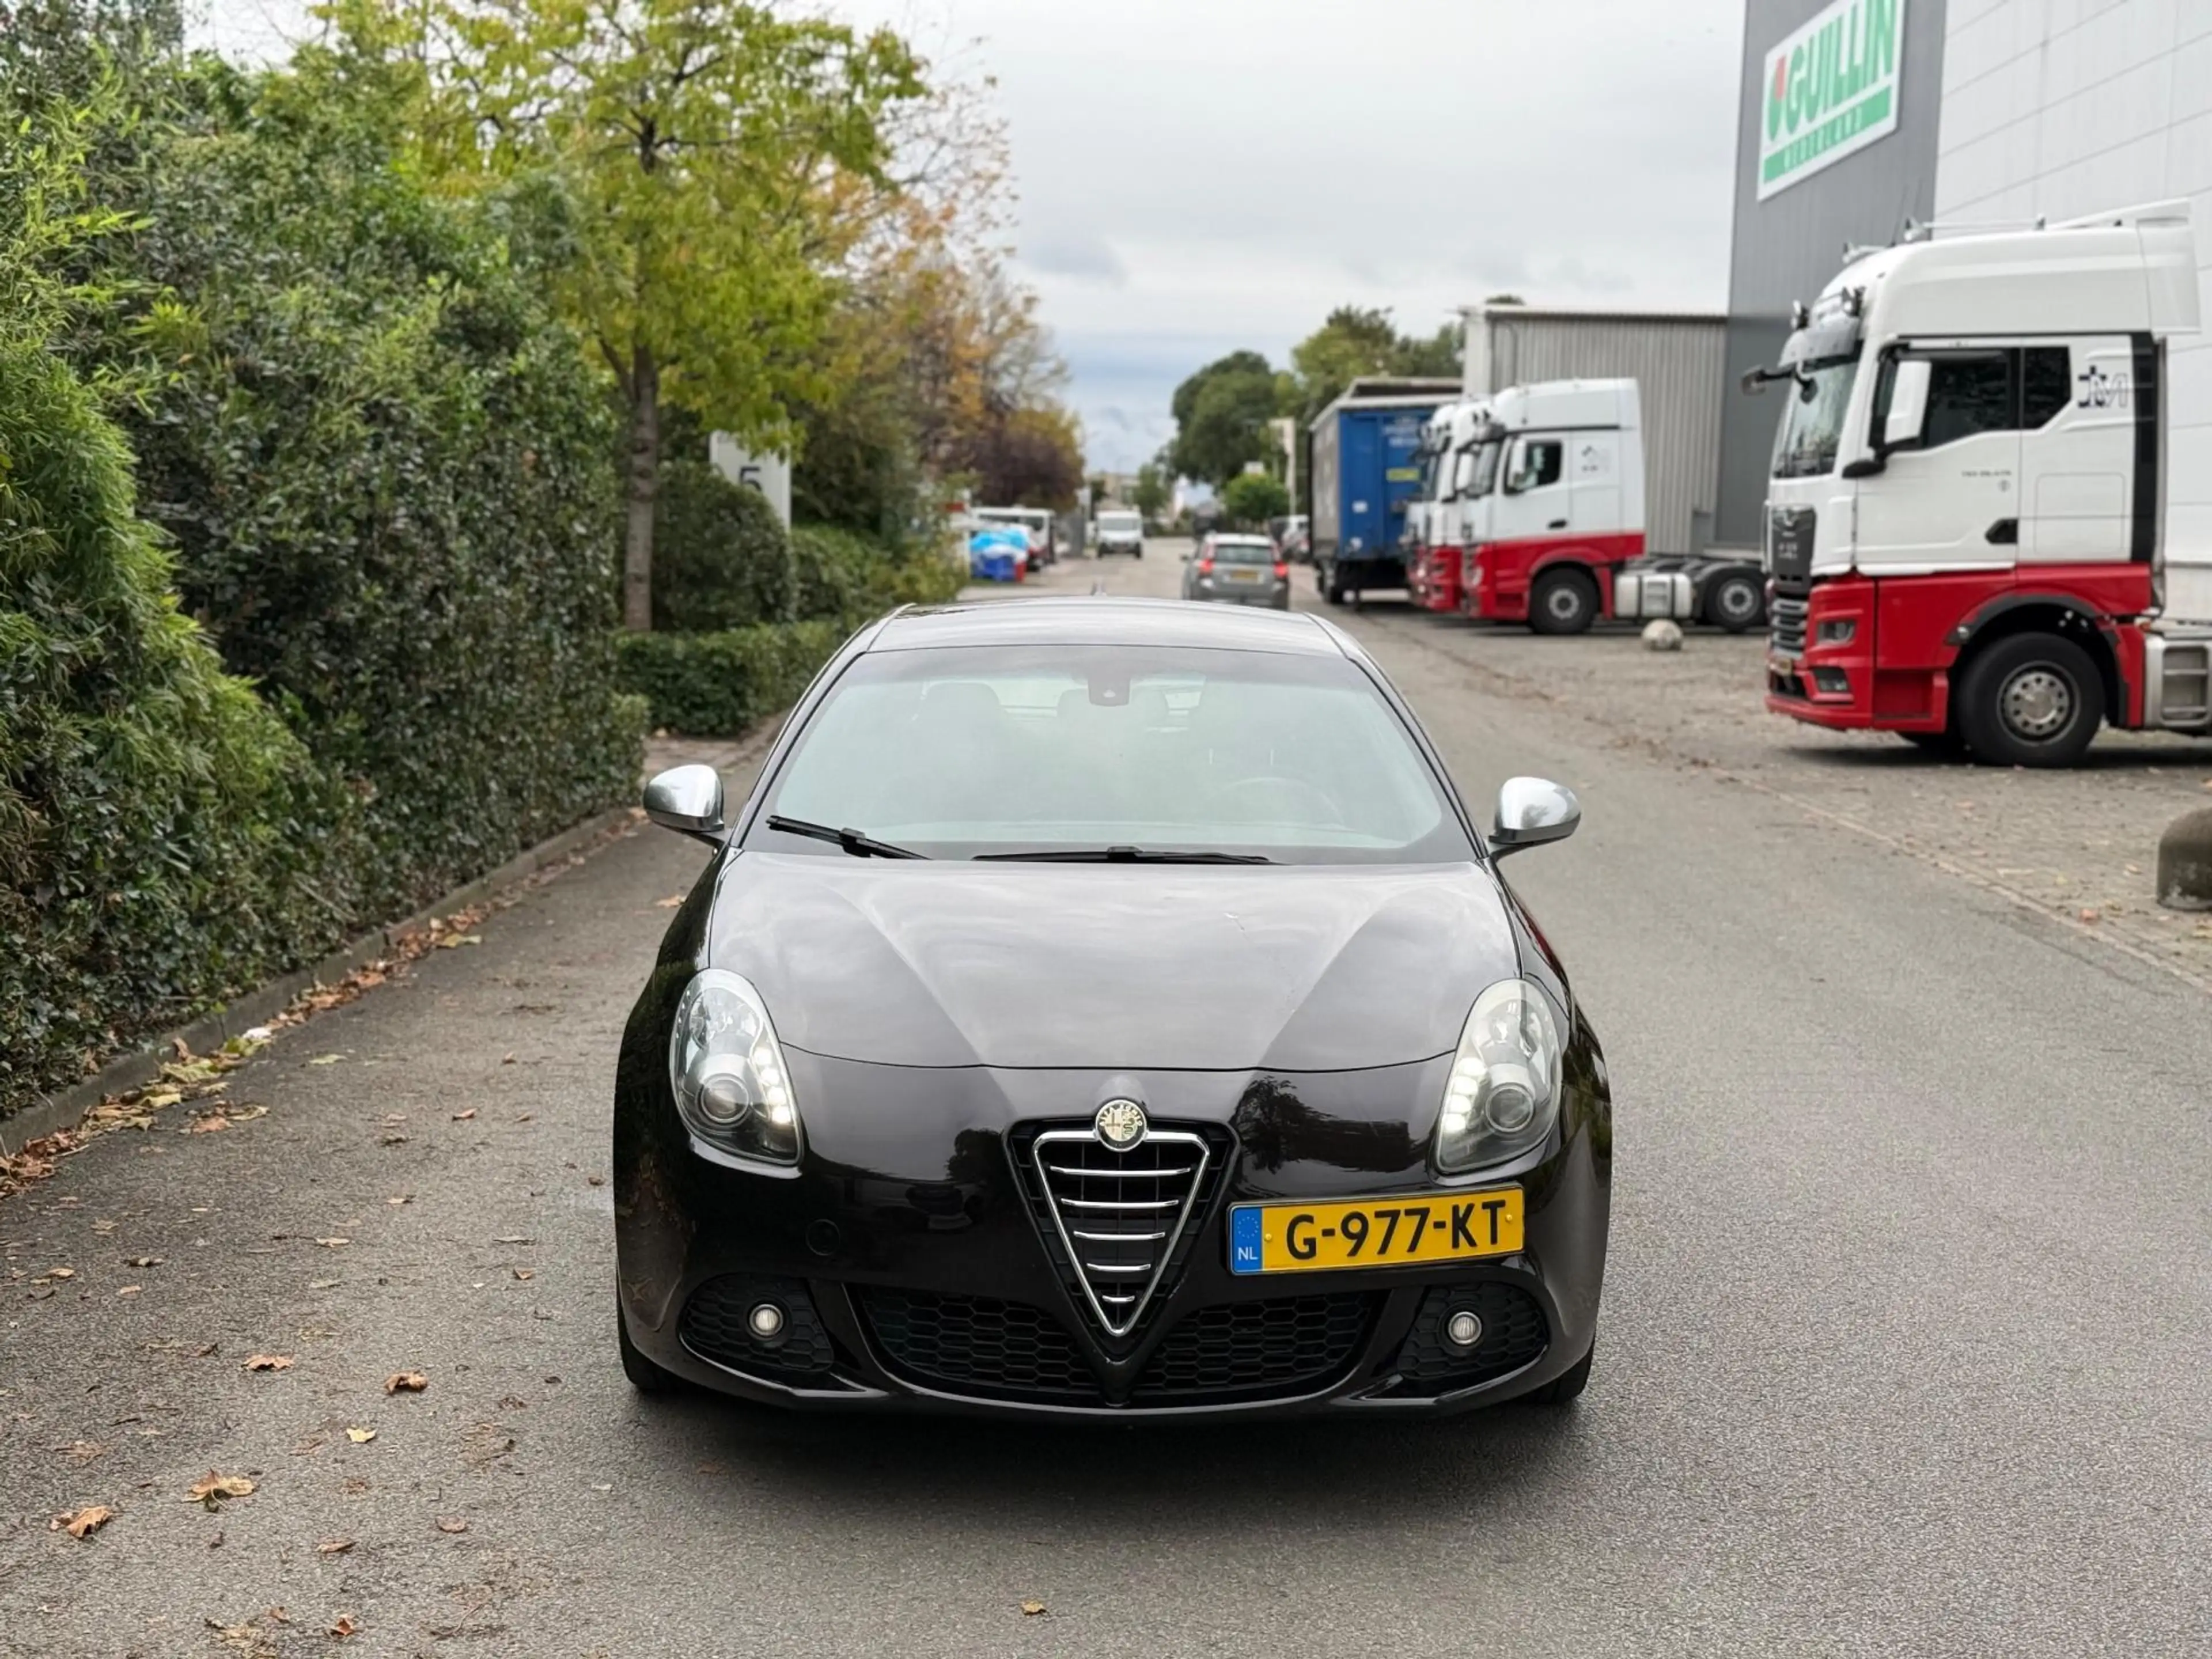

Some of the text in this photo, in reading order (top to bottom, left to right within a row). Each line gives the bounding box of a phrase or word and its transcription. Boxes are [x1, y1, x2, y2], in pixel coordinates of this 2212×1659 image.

[1786, 0, 1894, 134] GUILLIN
[1237, 1246, 1259, 1262] NL
[1286, 1199, 1507, 1260] G-977-KT
